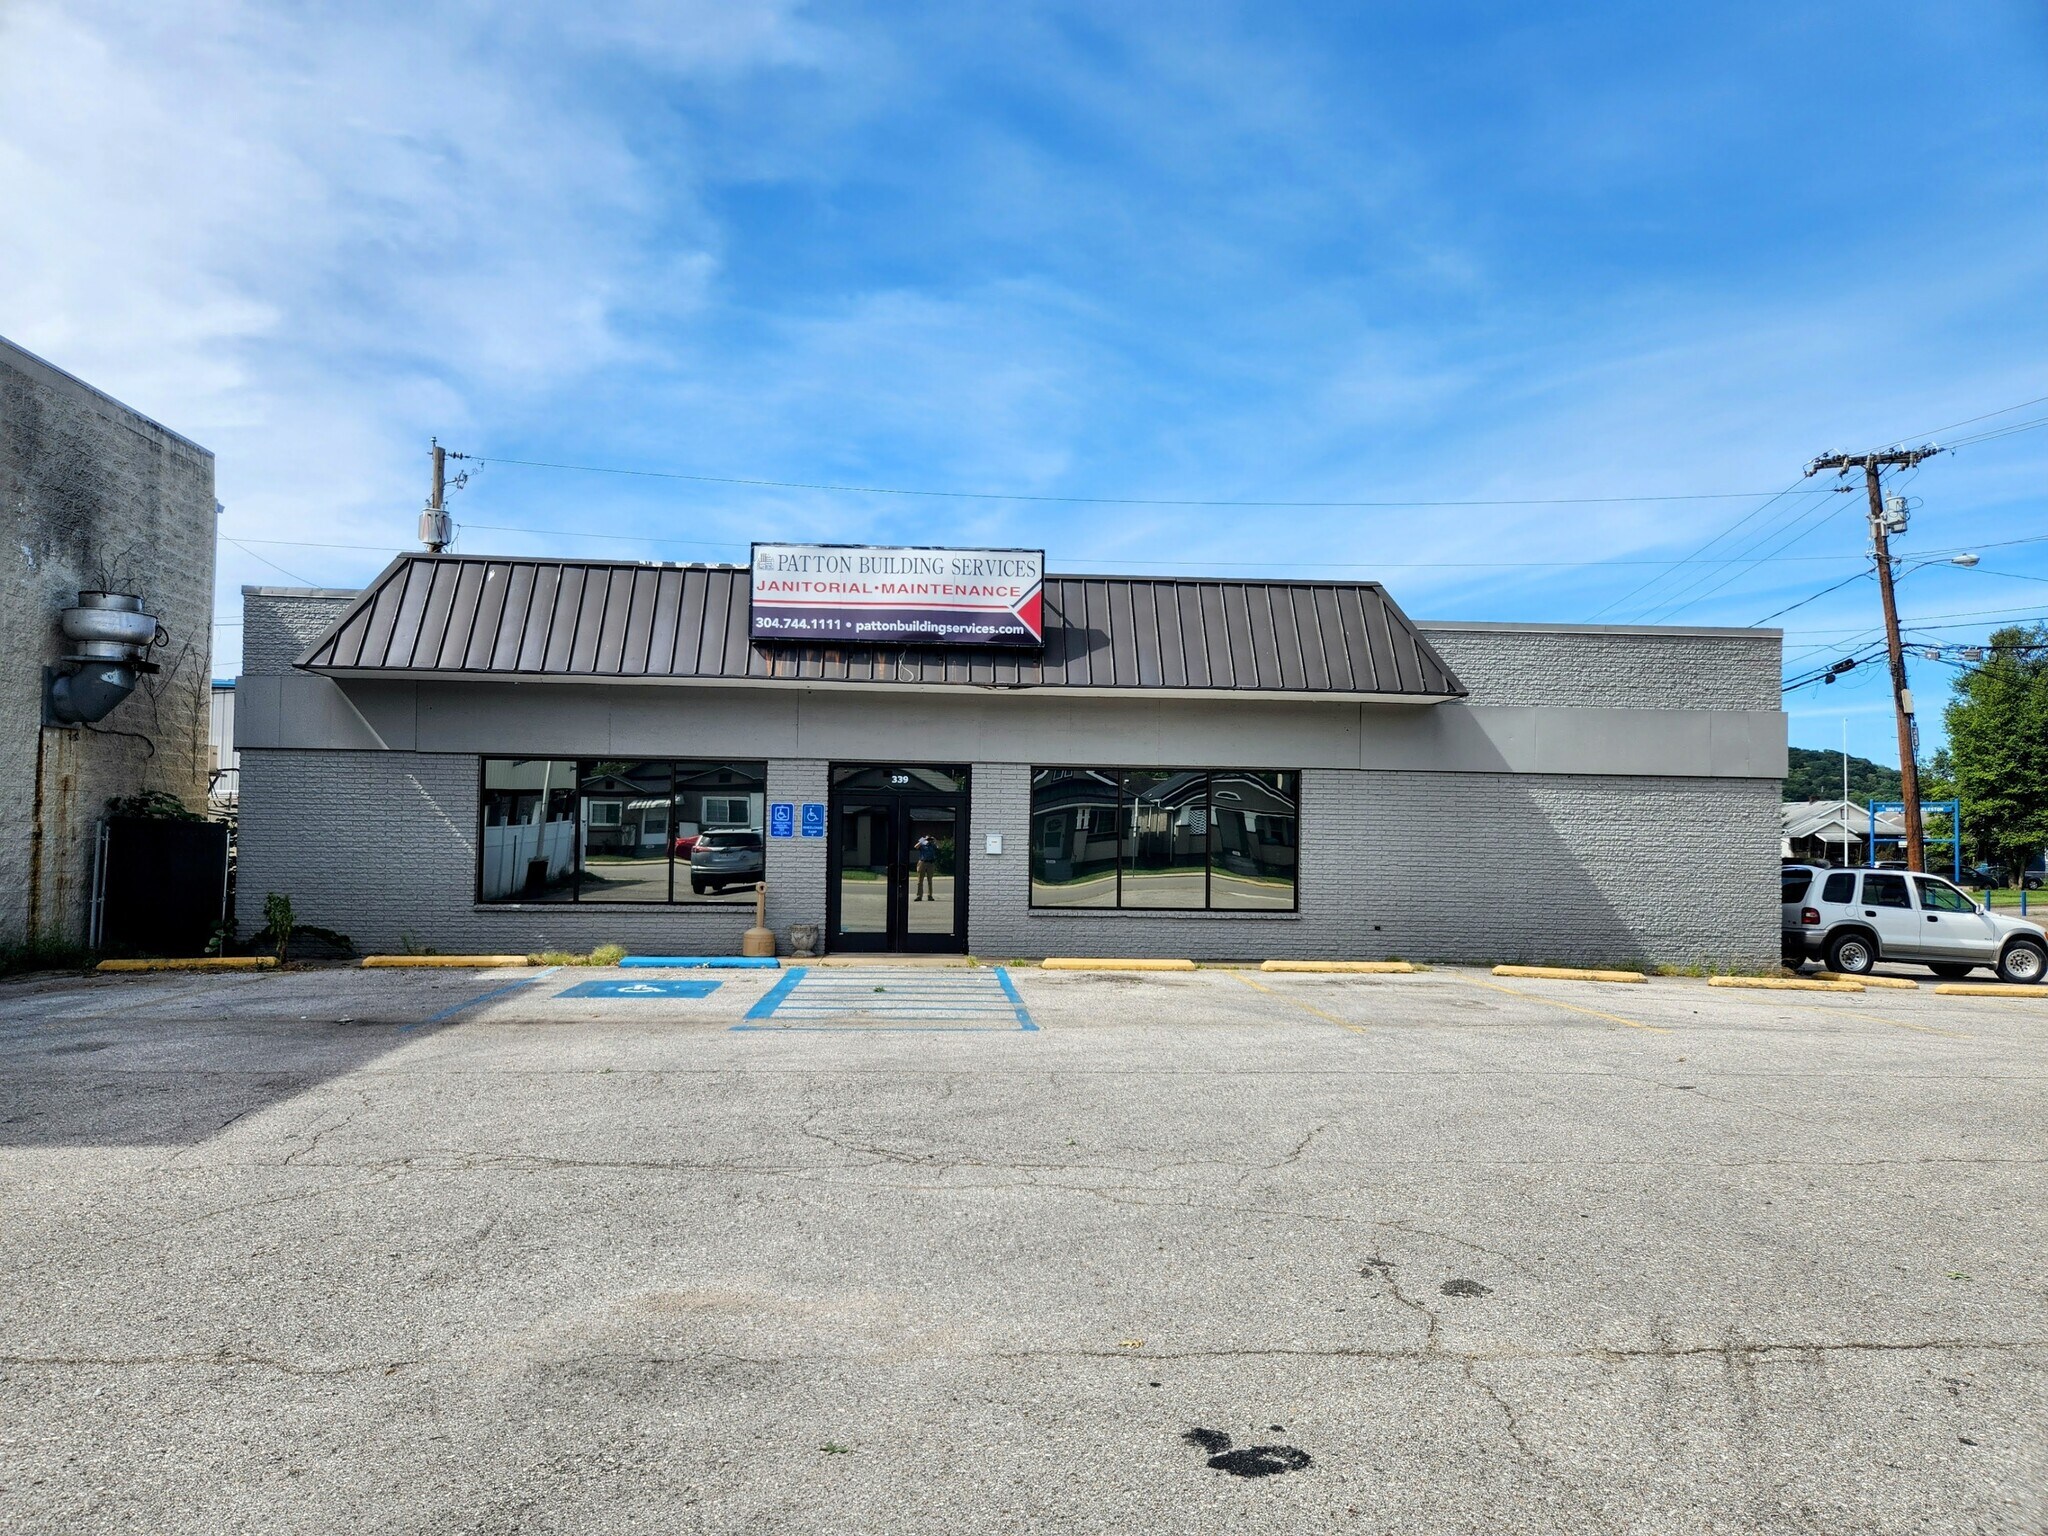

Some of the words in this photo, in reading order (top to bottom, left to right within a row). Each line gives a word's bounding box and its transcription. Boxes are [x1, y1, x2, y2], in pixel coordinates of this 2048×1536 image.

[777, 554, 852, 574] PATTON
[859, 556, 944, 575] BUILDING
[951, 557, 1036, 578] SERVICES
[755, 617, 841, 631] 304.744.1111
[856, 619, 1024, 635] pattonbuildingservices.com
[891, 775, 909, 784] 339
